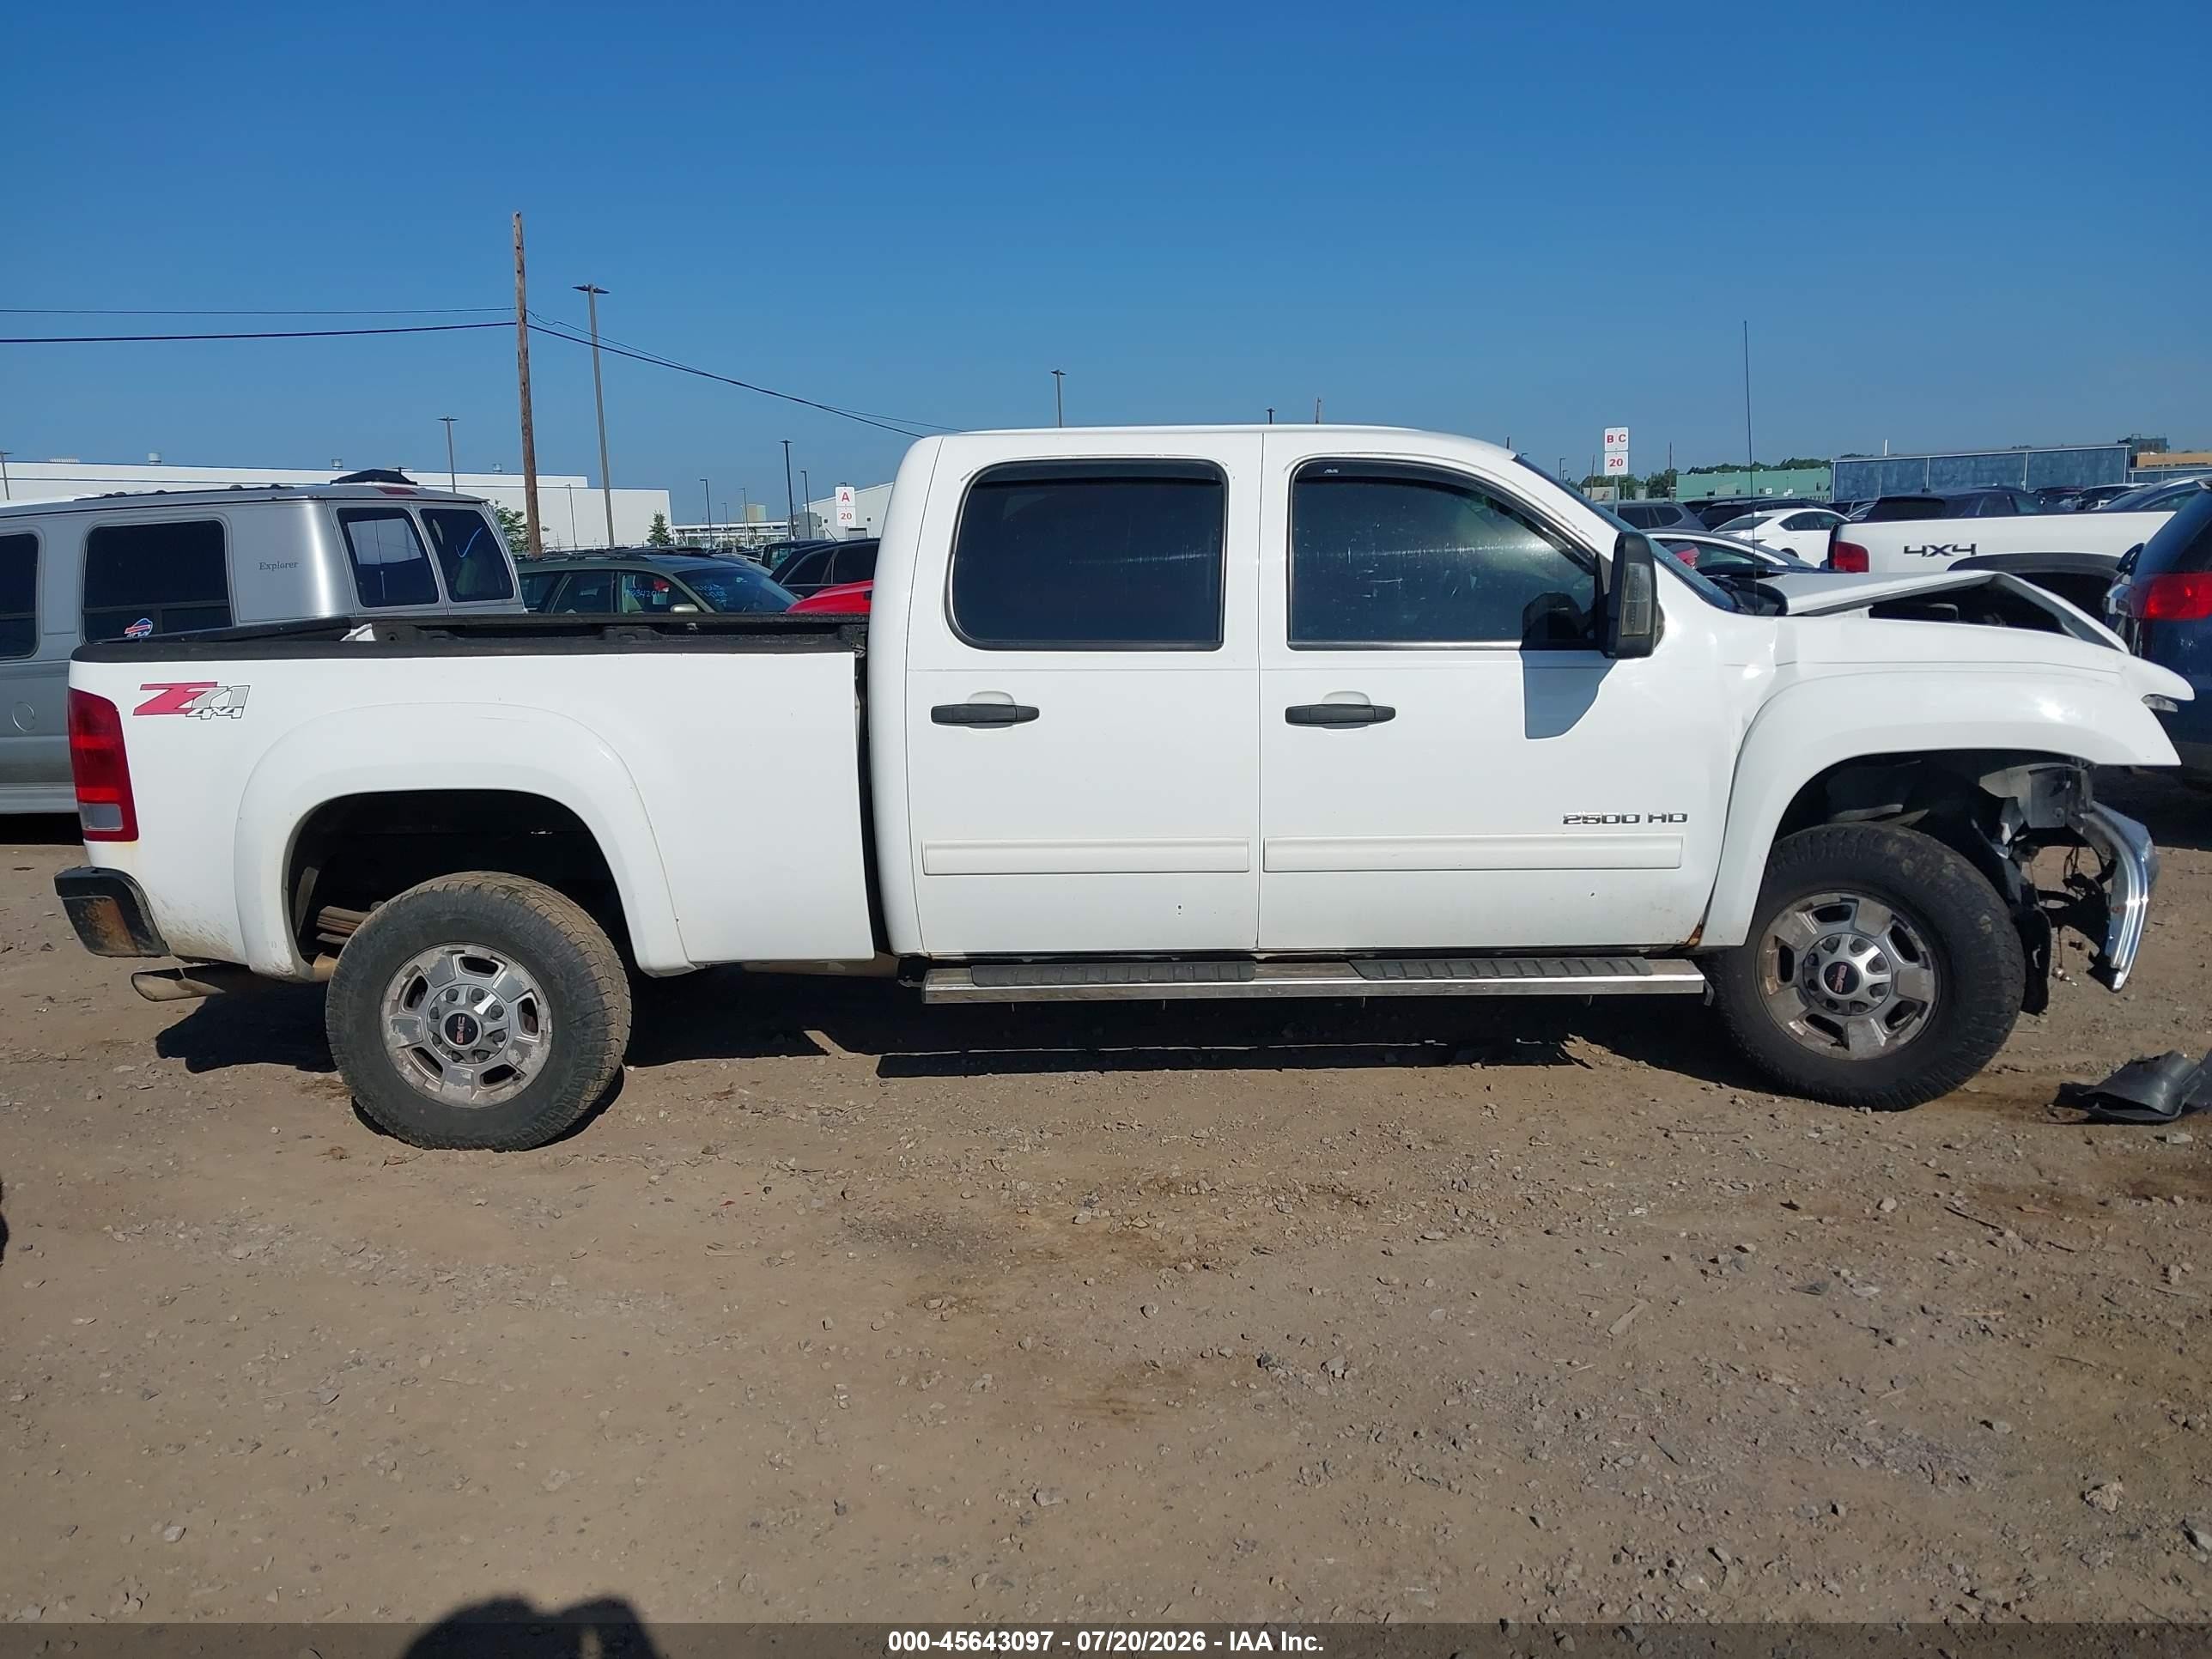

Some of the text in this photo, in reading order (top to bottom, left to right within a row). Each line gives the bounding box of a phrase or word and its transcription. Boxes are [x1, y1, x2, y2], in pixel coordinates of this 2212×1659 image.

[1607, 434, 1626, 444] B C
[1608, 458, 1624, 467] 20
[841, 491, 851, 502] A
[840, 512, 853, 520] 20
[258, 561, 298, 572] Explorer
[132, 681, 251, 716] Z71
[1562, 812, 1688, 825] 2500 HD
[455, 1016, 465, 1044] GMC
